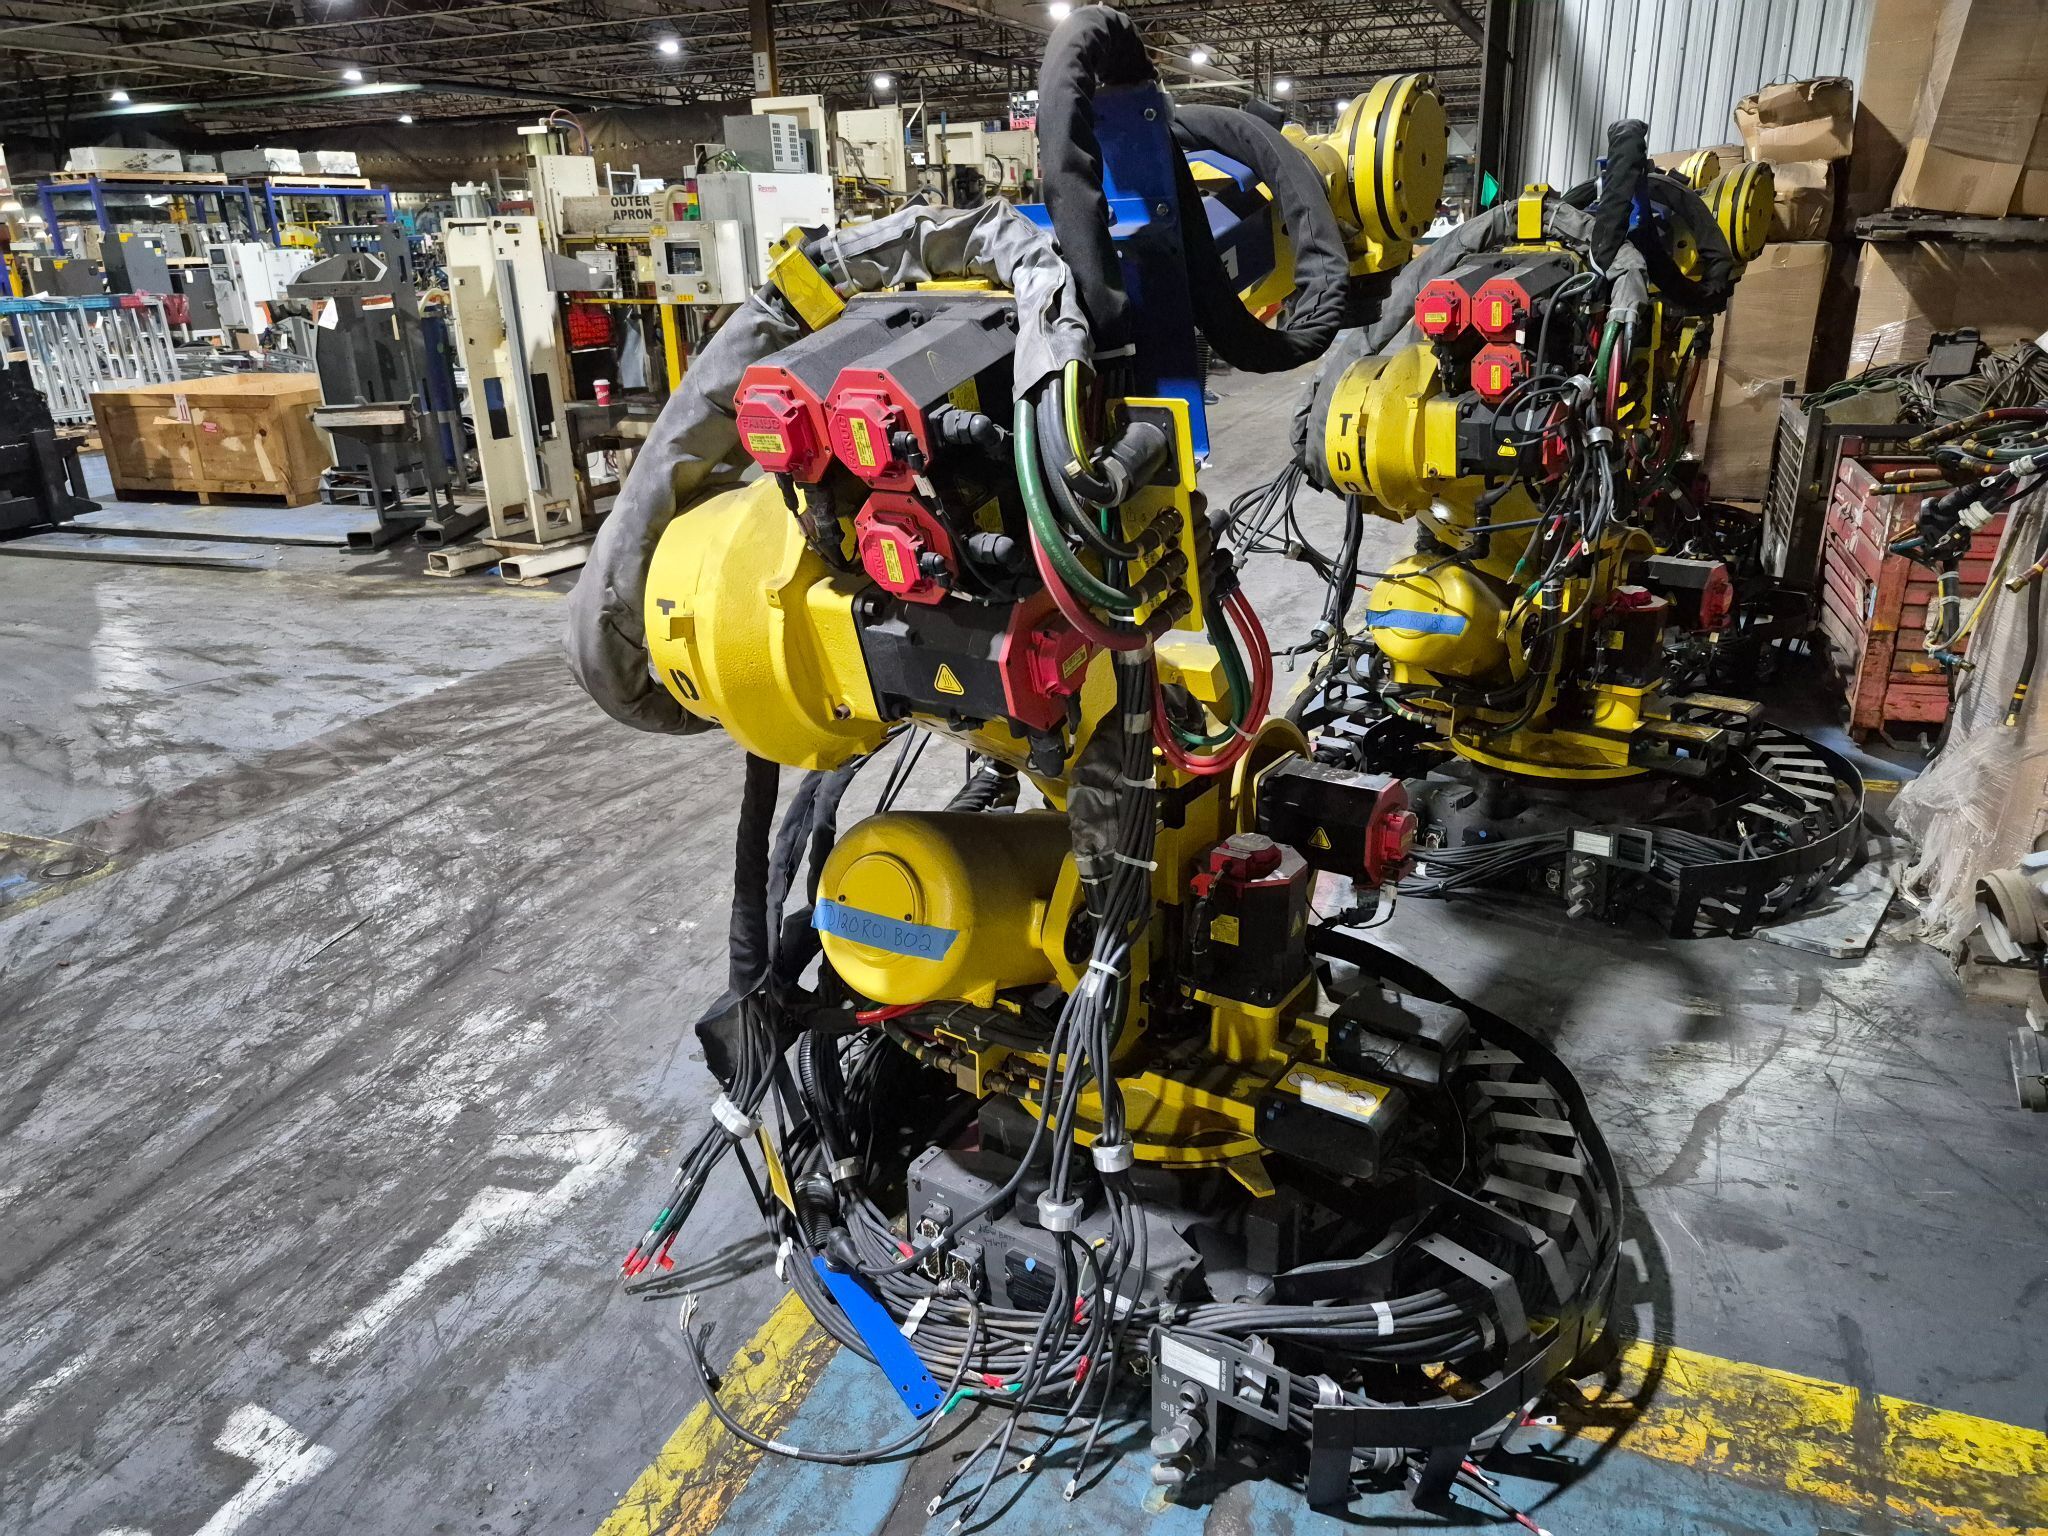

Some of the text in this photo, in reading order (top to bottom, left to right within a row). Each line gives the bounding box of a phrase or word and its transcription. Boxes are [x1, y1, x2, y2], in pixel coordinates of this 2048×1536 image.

[611, 195, 650, 207] OUTER
[613, 208, 653, 221] APRON
[741, 417, 781, 430] FANUC
[894, 927, 933, 951] B02
